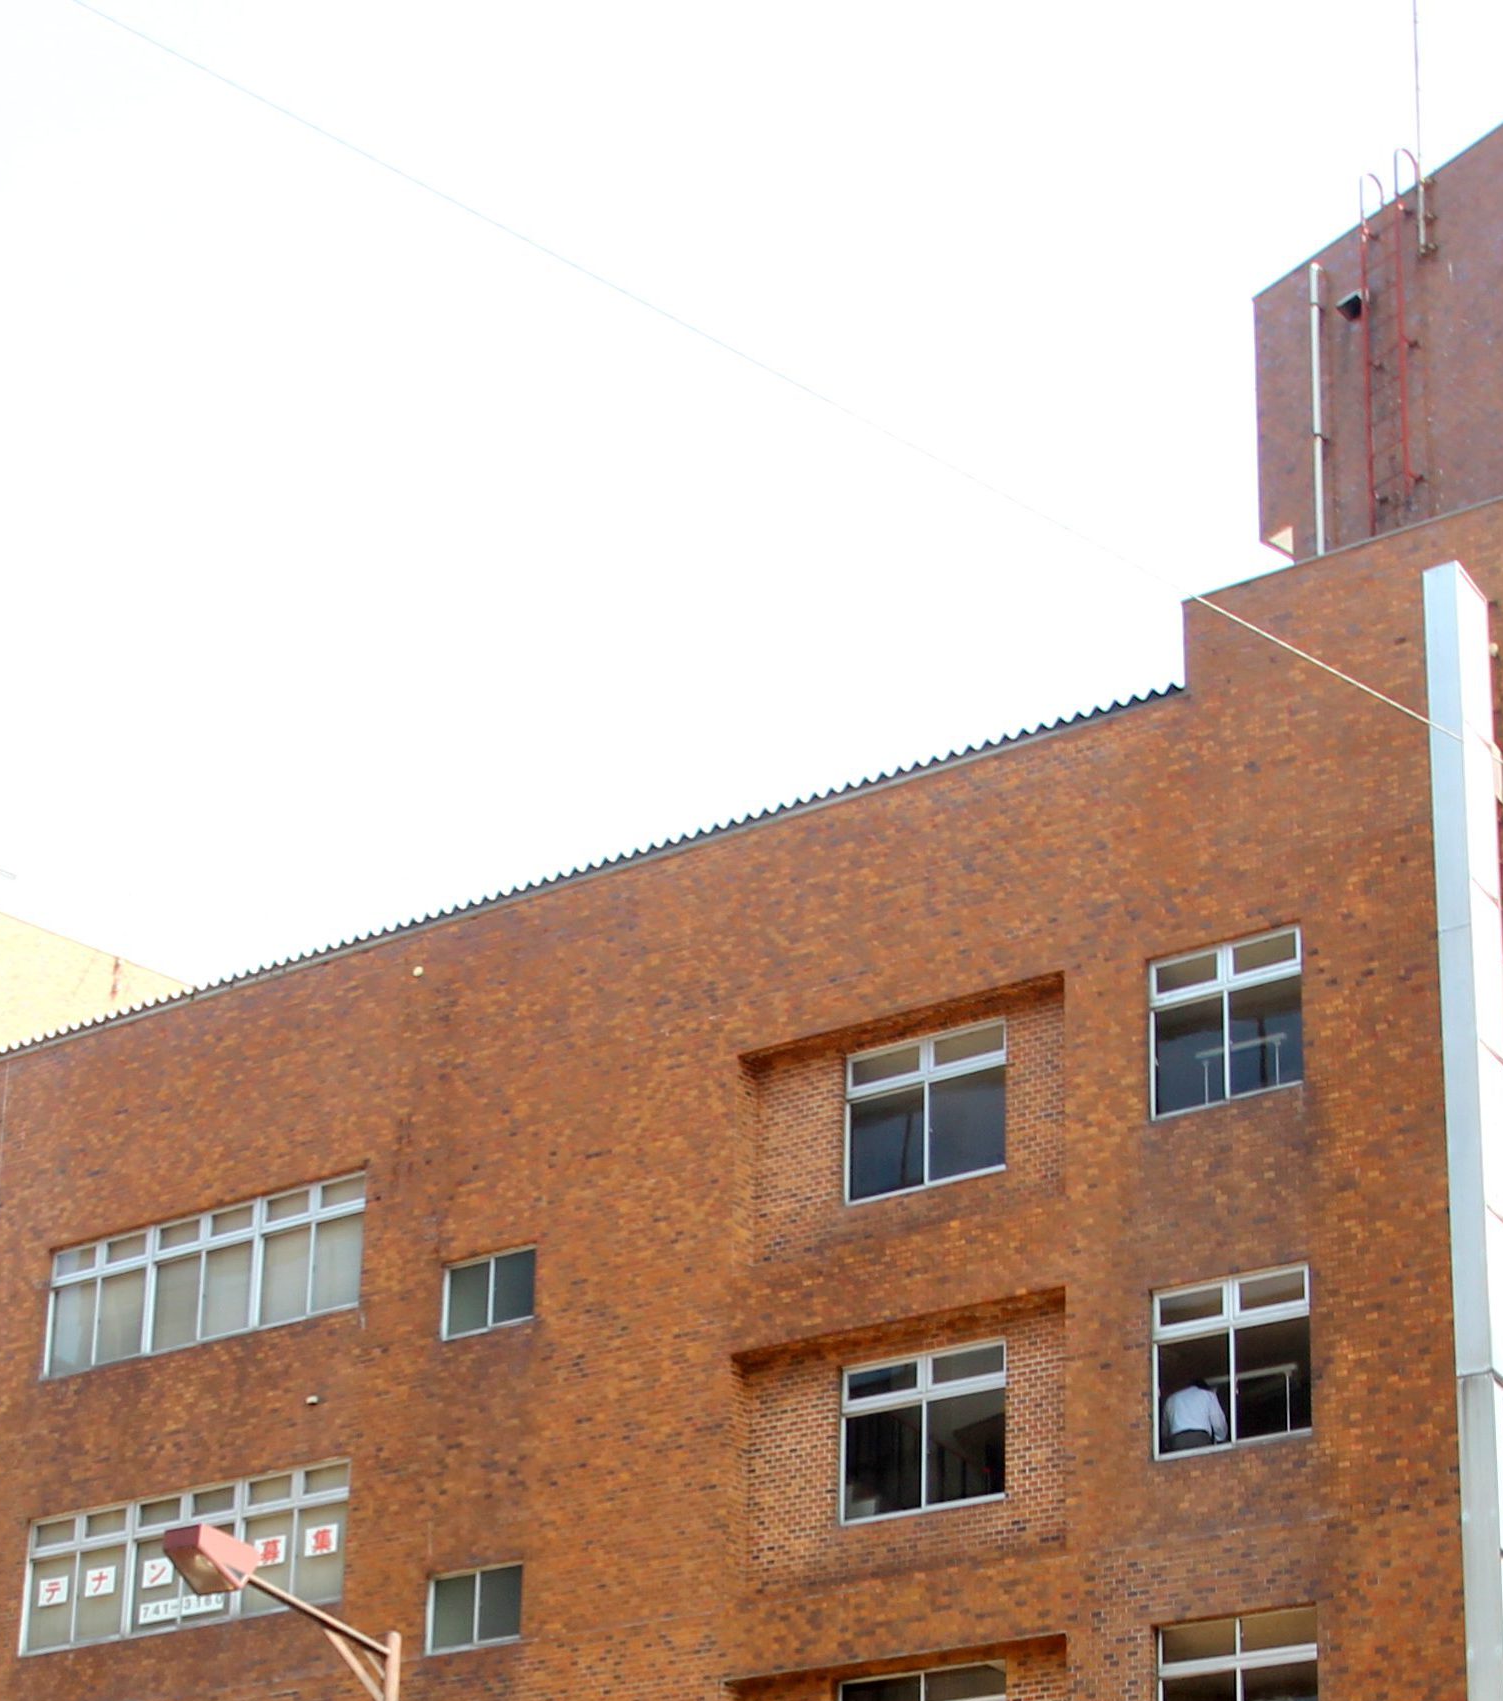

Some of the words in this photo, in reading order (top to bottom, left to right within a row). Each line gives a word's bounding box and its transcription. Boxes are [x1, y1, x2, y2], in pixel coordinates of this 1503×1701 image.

[45, 1528, 332, 1603] テナン募集
